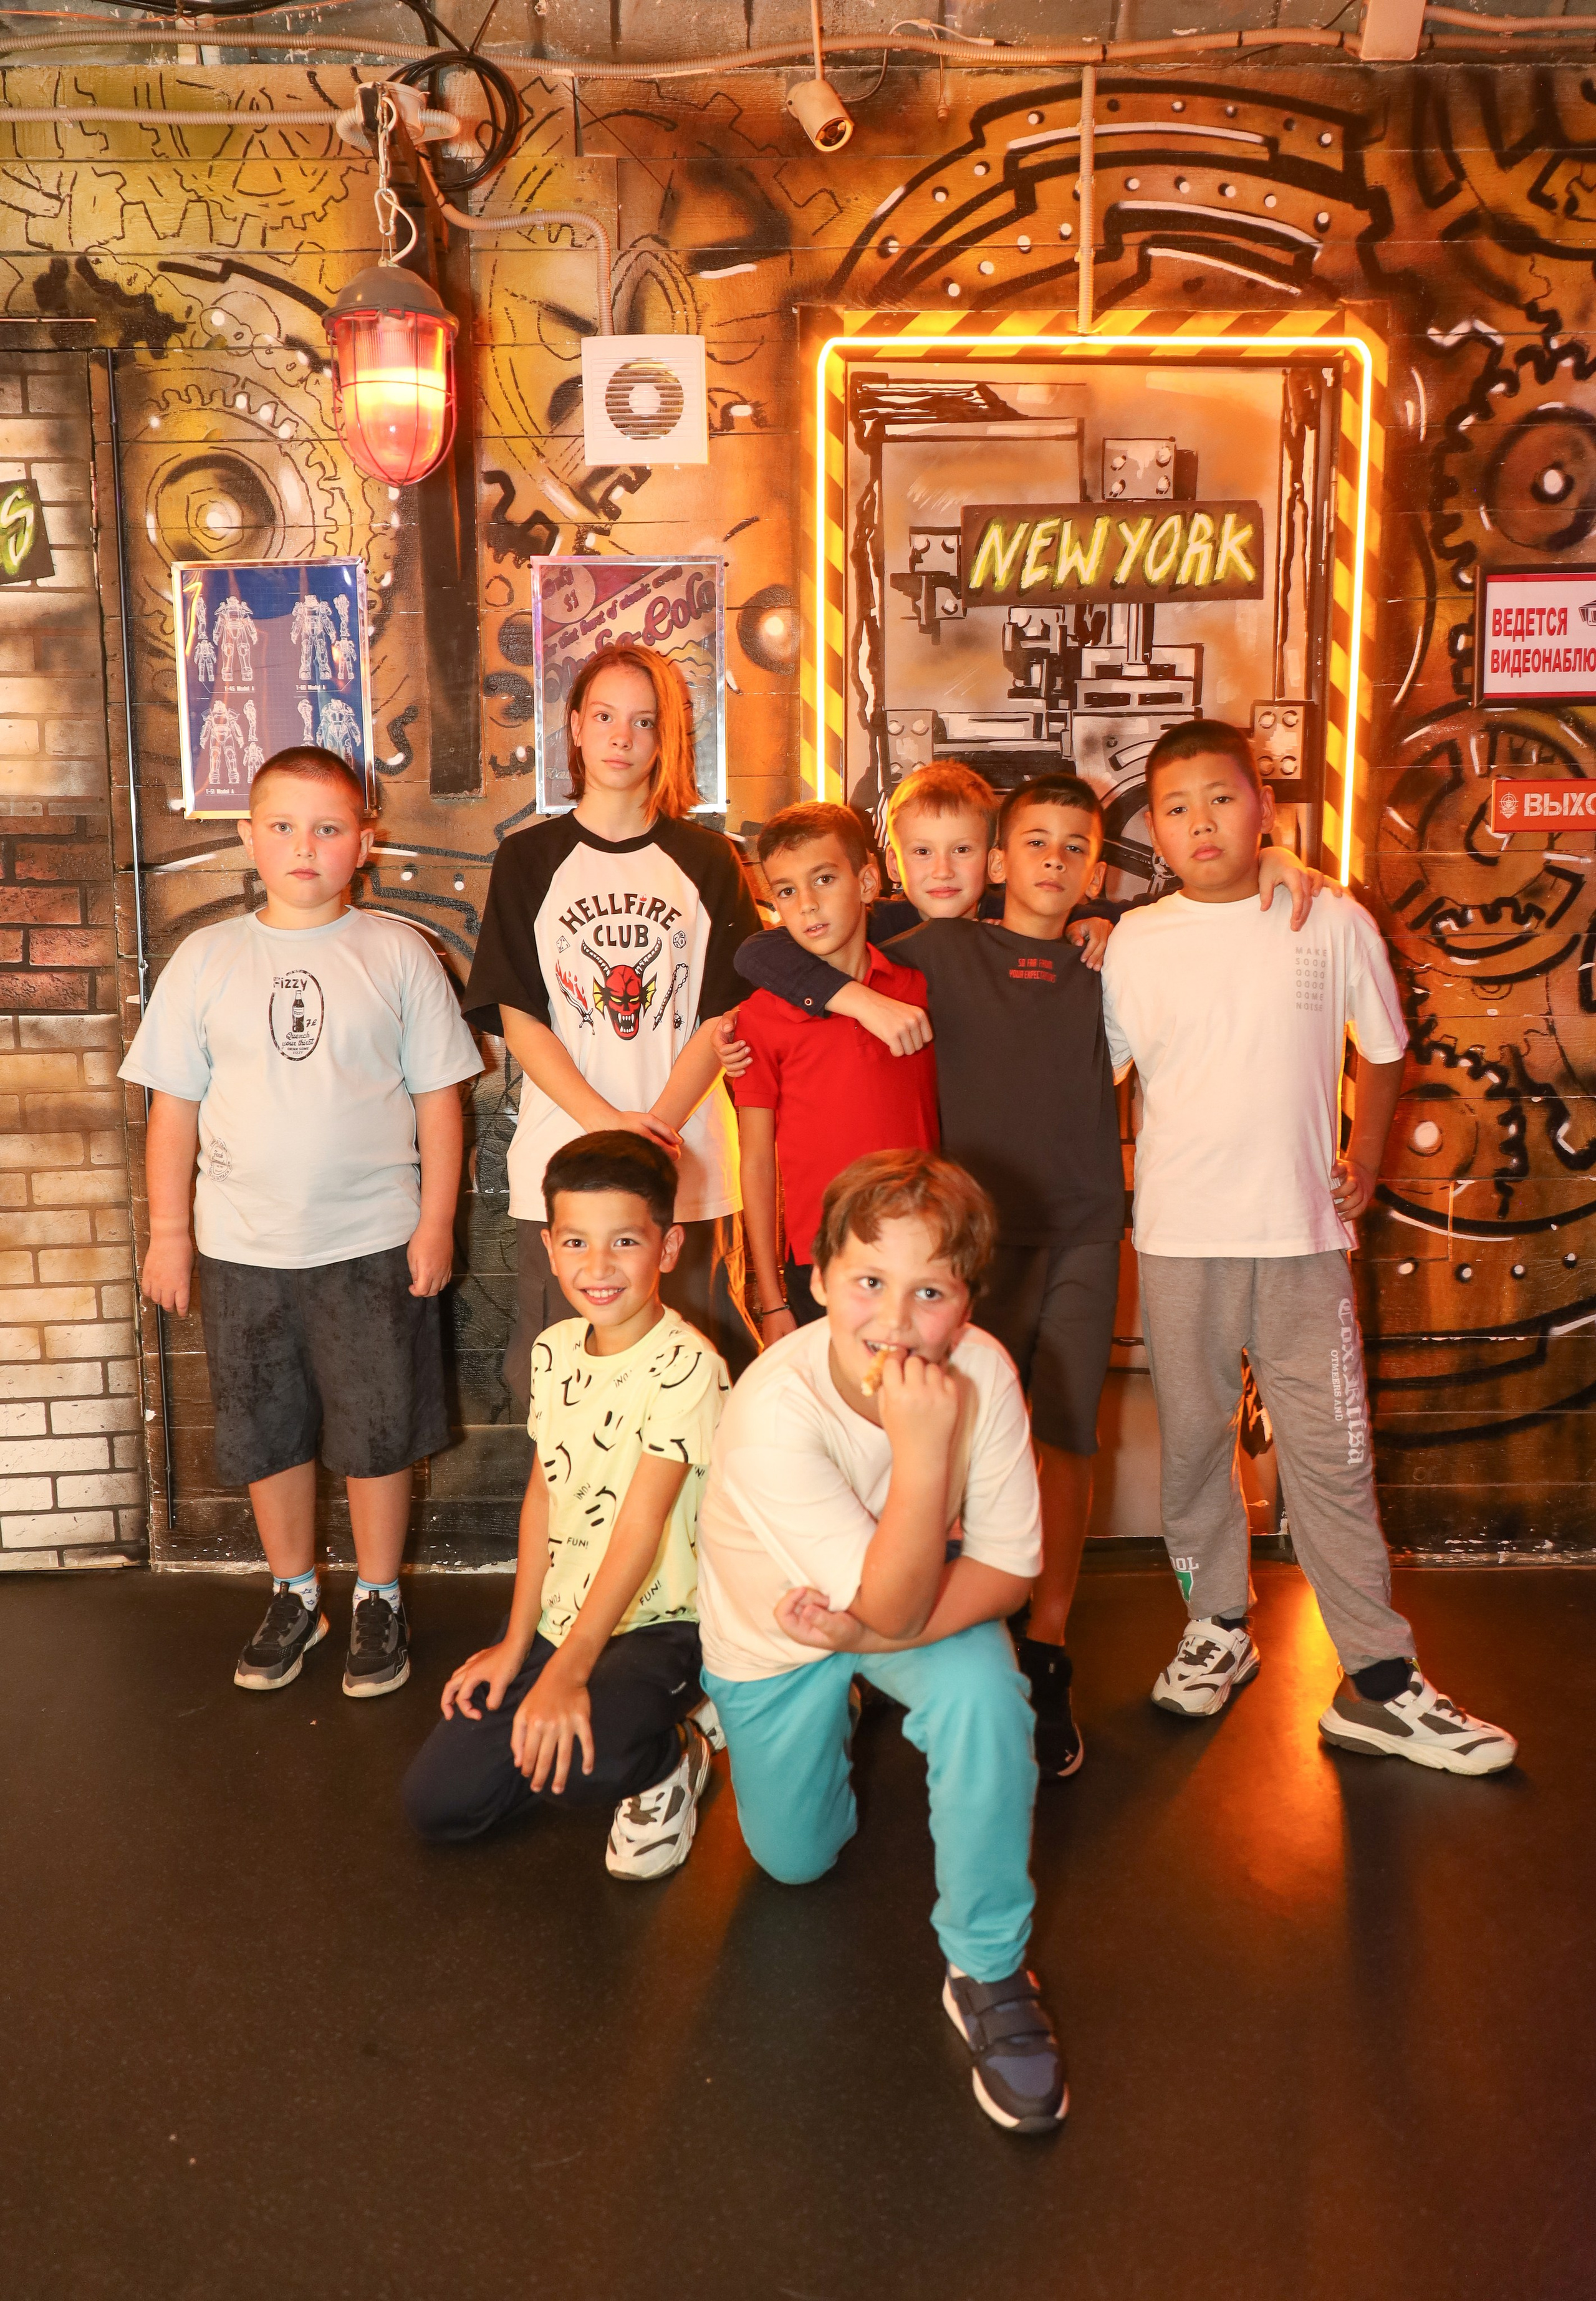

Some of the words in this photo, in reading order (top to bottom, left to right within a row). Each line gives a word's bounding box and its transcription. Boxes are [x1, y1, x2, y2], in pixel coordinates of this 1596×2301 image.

[968, 515, 1111, 590] NEW
[1113, 511, 1255, 588] YORK
[1492, 607, 1568, 642] ВЕДЕТСЯ
[1491, 648, 1596, 678] ВИДЕОНАБЛЮ
[593, 924, 649, 948] CLUB
[1295, 946, 1327, 957] MAKE
[1296, 1002, 1324, 1012] NOISE
[286, 1031, 310, 1040] Quench
[1334, 1398, 1344, 1422] AND
[566, 1537, 589, 1550] FUN!
[639, 1579, 662, 1606] FUN!
